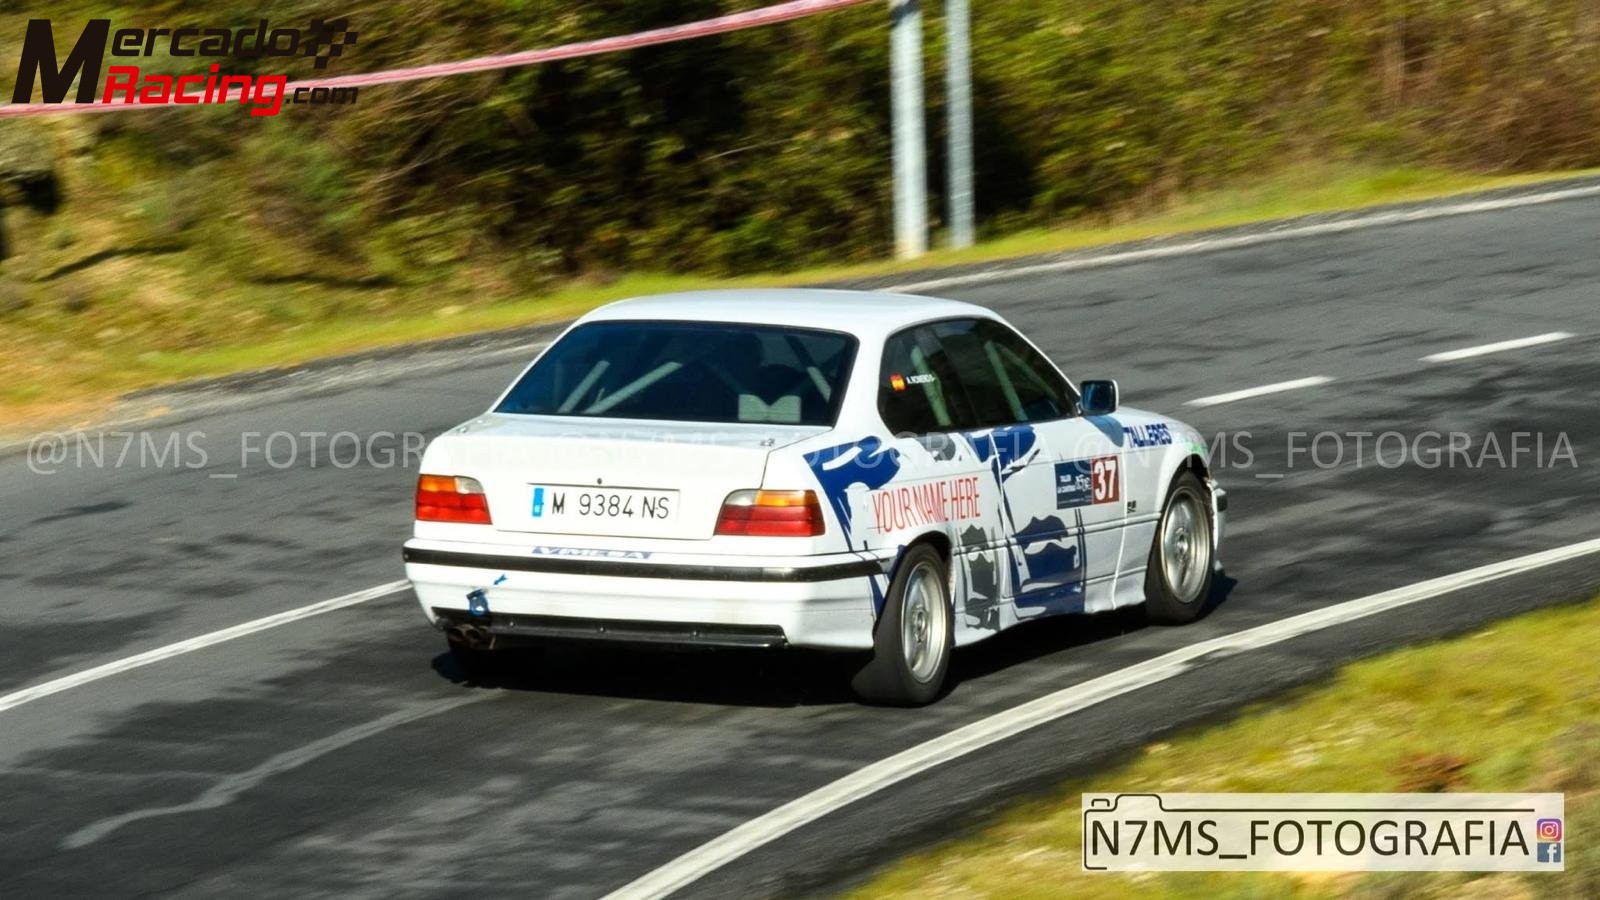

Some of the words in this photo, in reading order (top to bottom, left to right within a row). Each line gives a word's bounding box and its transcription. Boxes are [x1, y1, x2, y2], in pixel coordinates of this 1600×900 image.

[1123, 423, 1172, 448] TALLERES
[1093, 460, 1116, 500] 37
[552, 492, 565, 514] M
[579, 493, 634, 517] 9384
[642, 495, 669, 519] NS
[872, 487, 918, 534] YOUR
[912, 481, 949, 523] NAME
[949, 477, 980, 520] HERE
